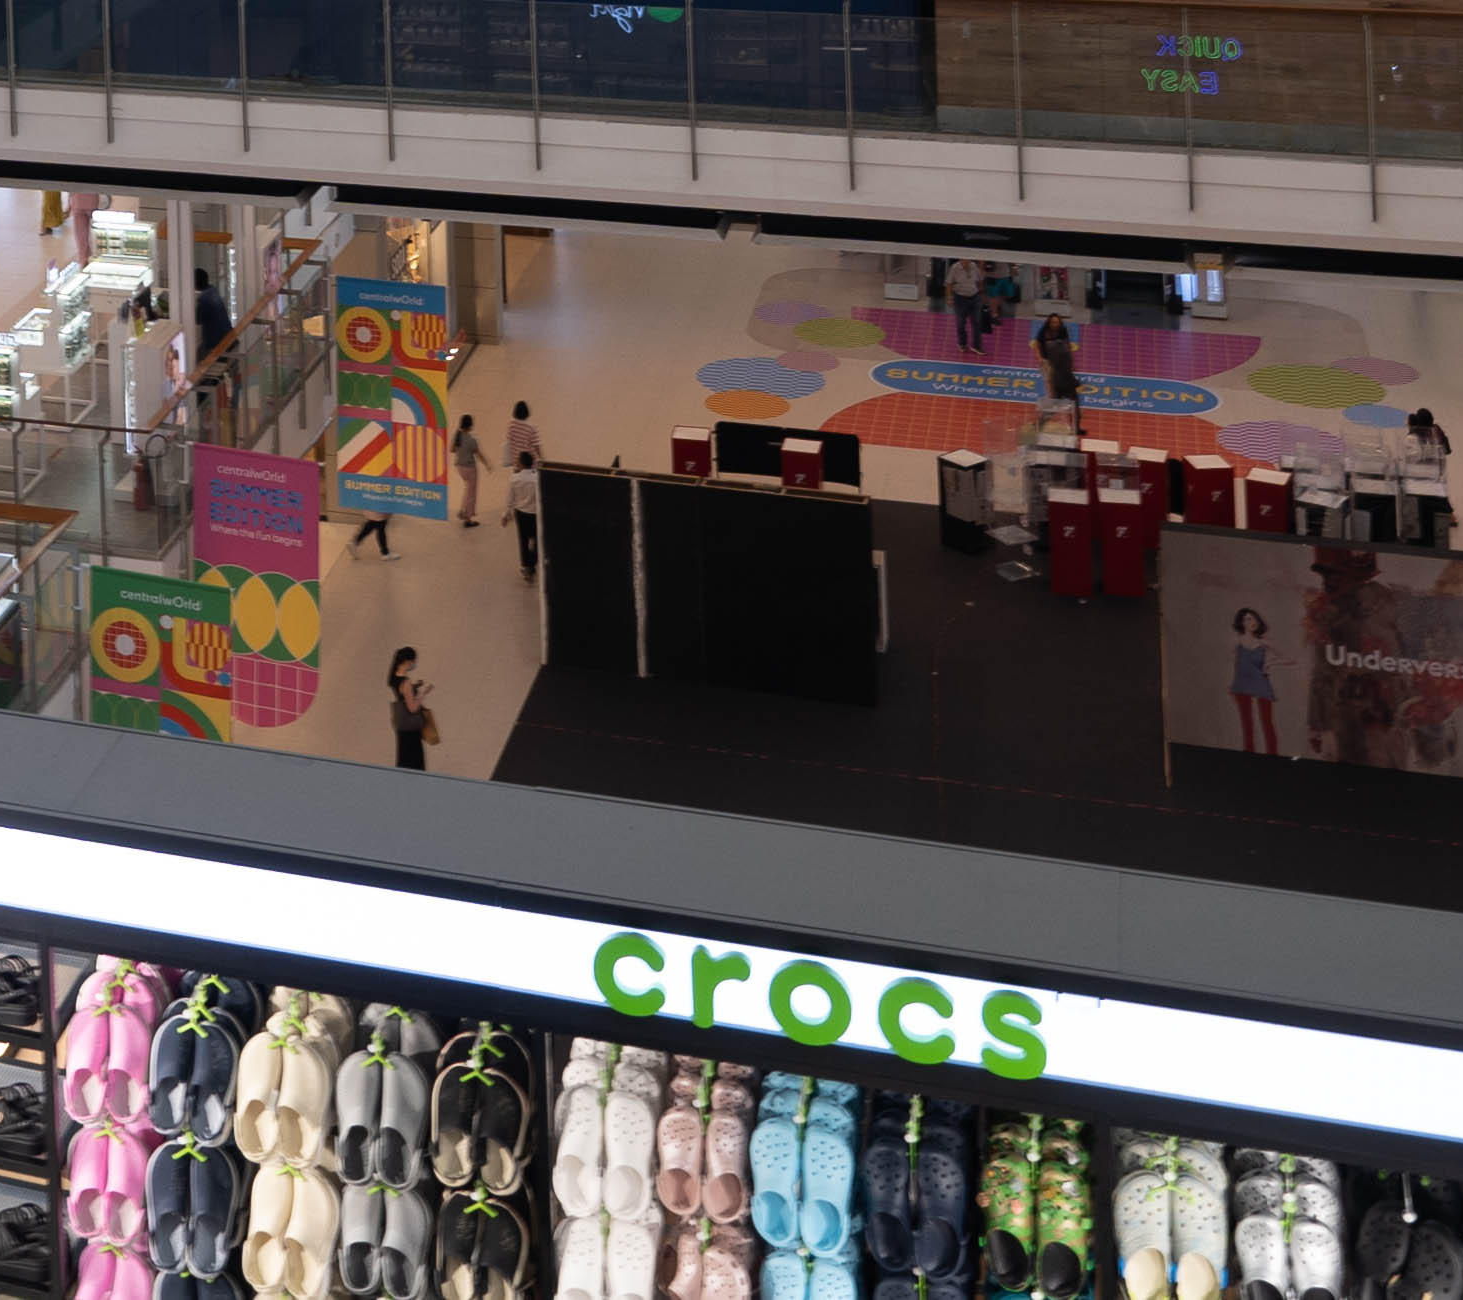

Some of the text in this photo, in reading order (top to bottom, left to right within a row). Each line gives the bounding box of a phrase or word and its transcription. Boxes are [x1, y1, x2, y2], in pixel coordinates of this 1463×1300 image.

[885, 367, 1205, 403] SUMMER DITION
[931, 382, 1155, 409] Where the begins
[209, 479, 304, 511] SUMMER
[344, 479, 442, 501] SUMMER EDITION
[209, 501, 304, 535] EDITION
[593, 930, 1049, 1081] crocs
